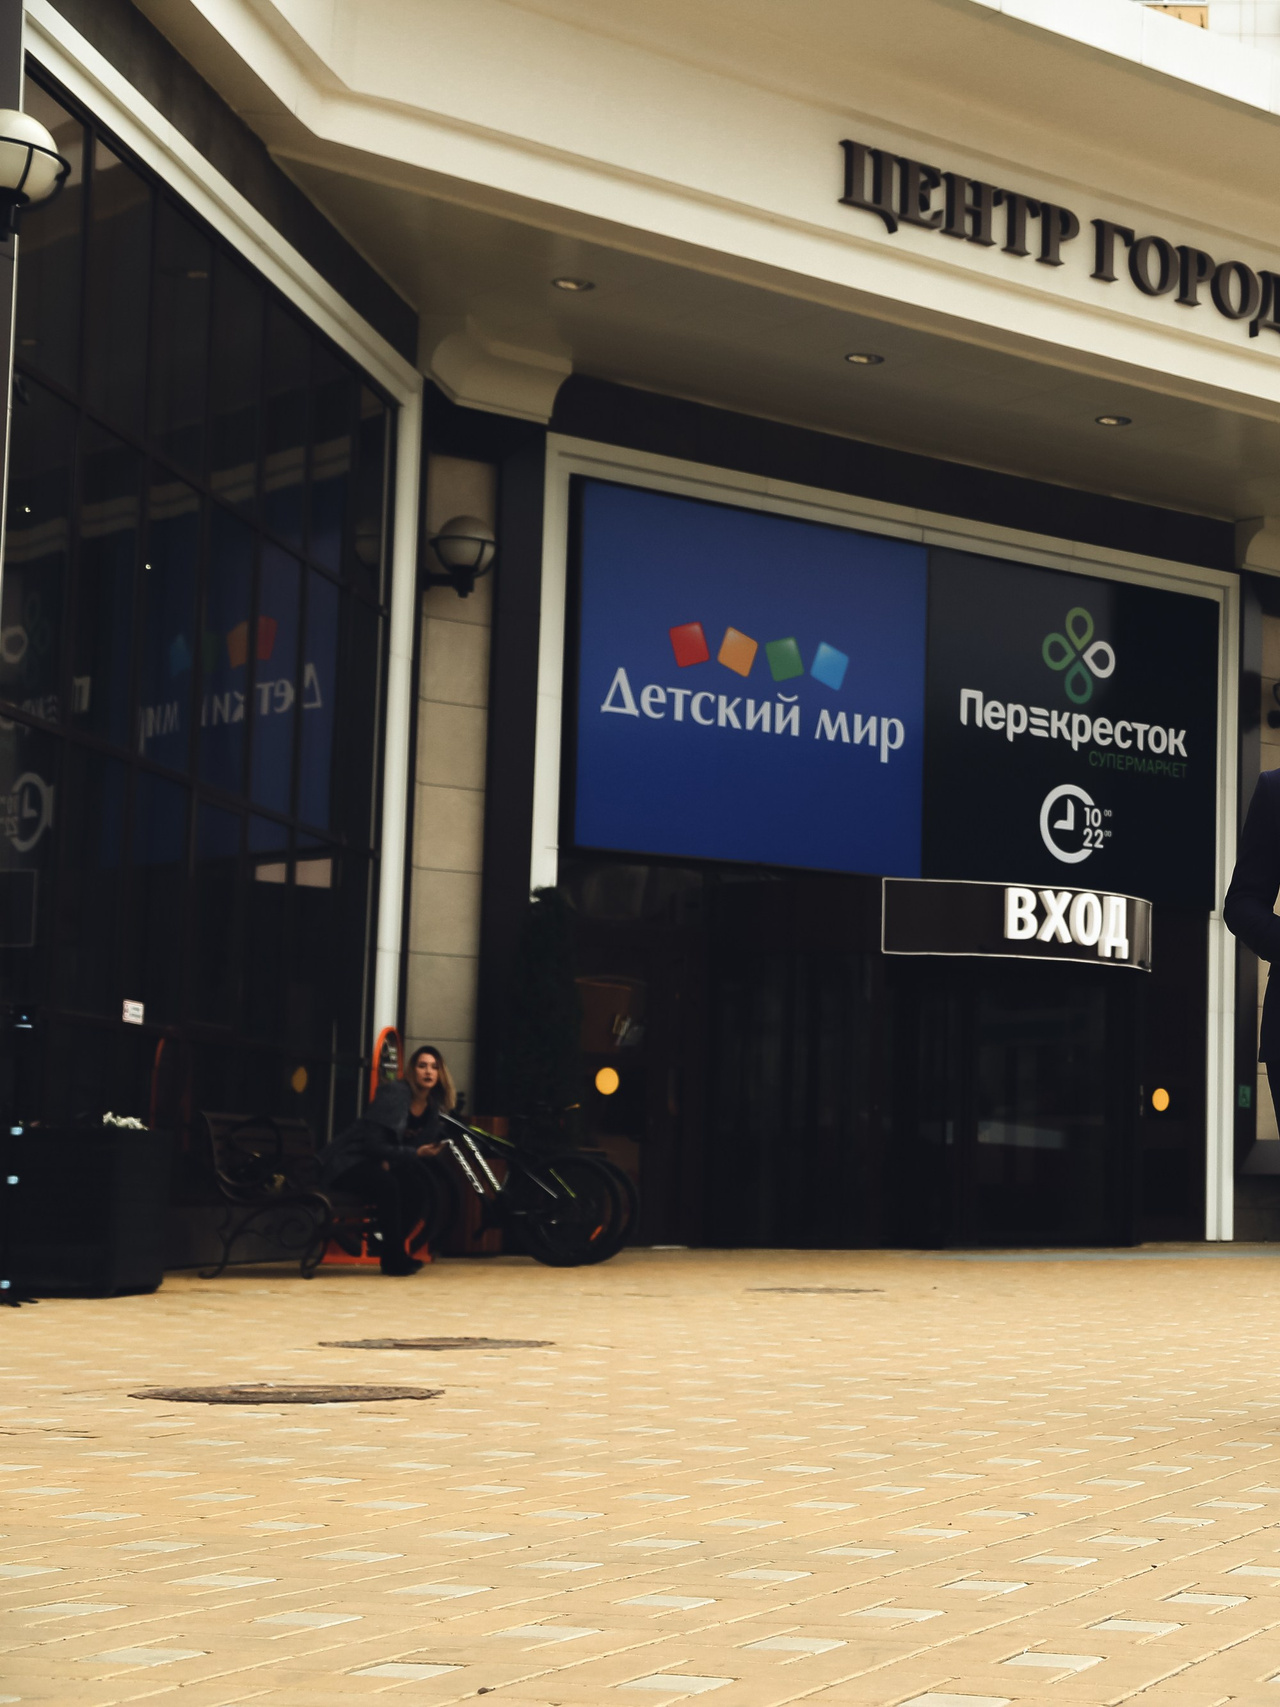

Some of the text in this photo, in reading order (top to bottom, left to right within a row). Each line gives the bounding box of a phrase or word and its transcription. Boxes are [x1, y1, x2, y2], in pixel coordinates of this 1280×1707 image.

[838, 139, 1080, 267] ЦЕНТР
[601, 667, 905, 764] Детский мир
[1089, 750, 1188, 779] СУПЕРМАРКЕТ
[1004, 887, 1129, 960] ВХОД
